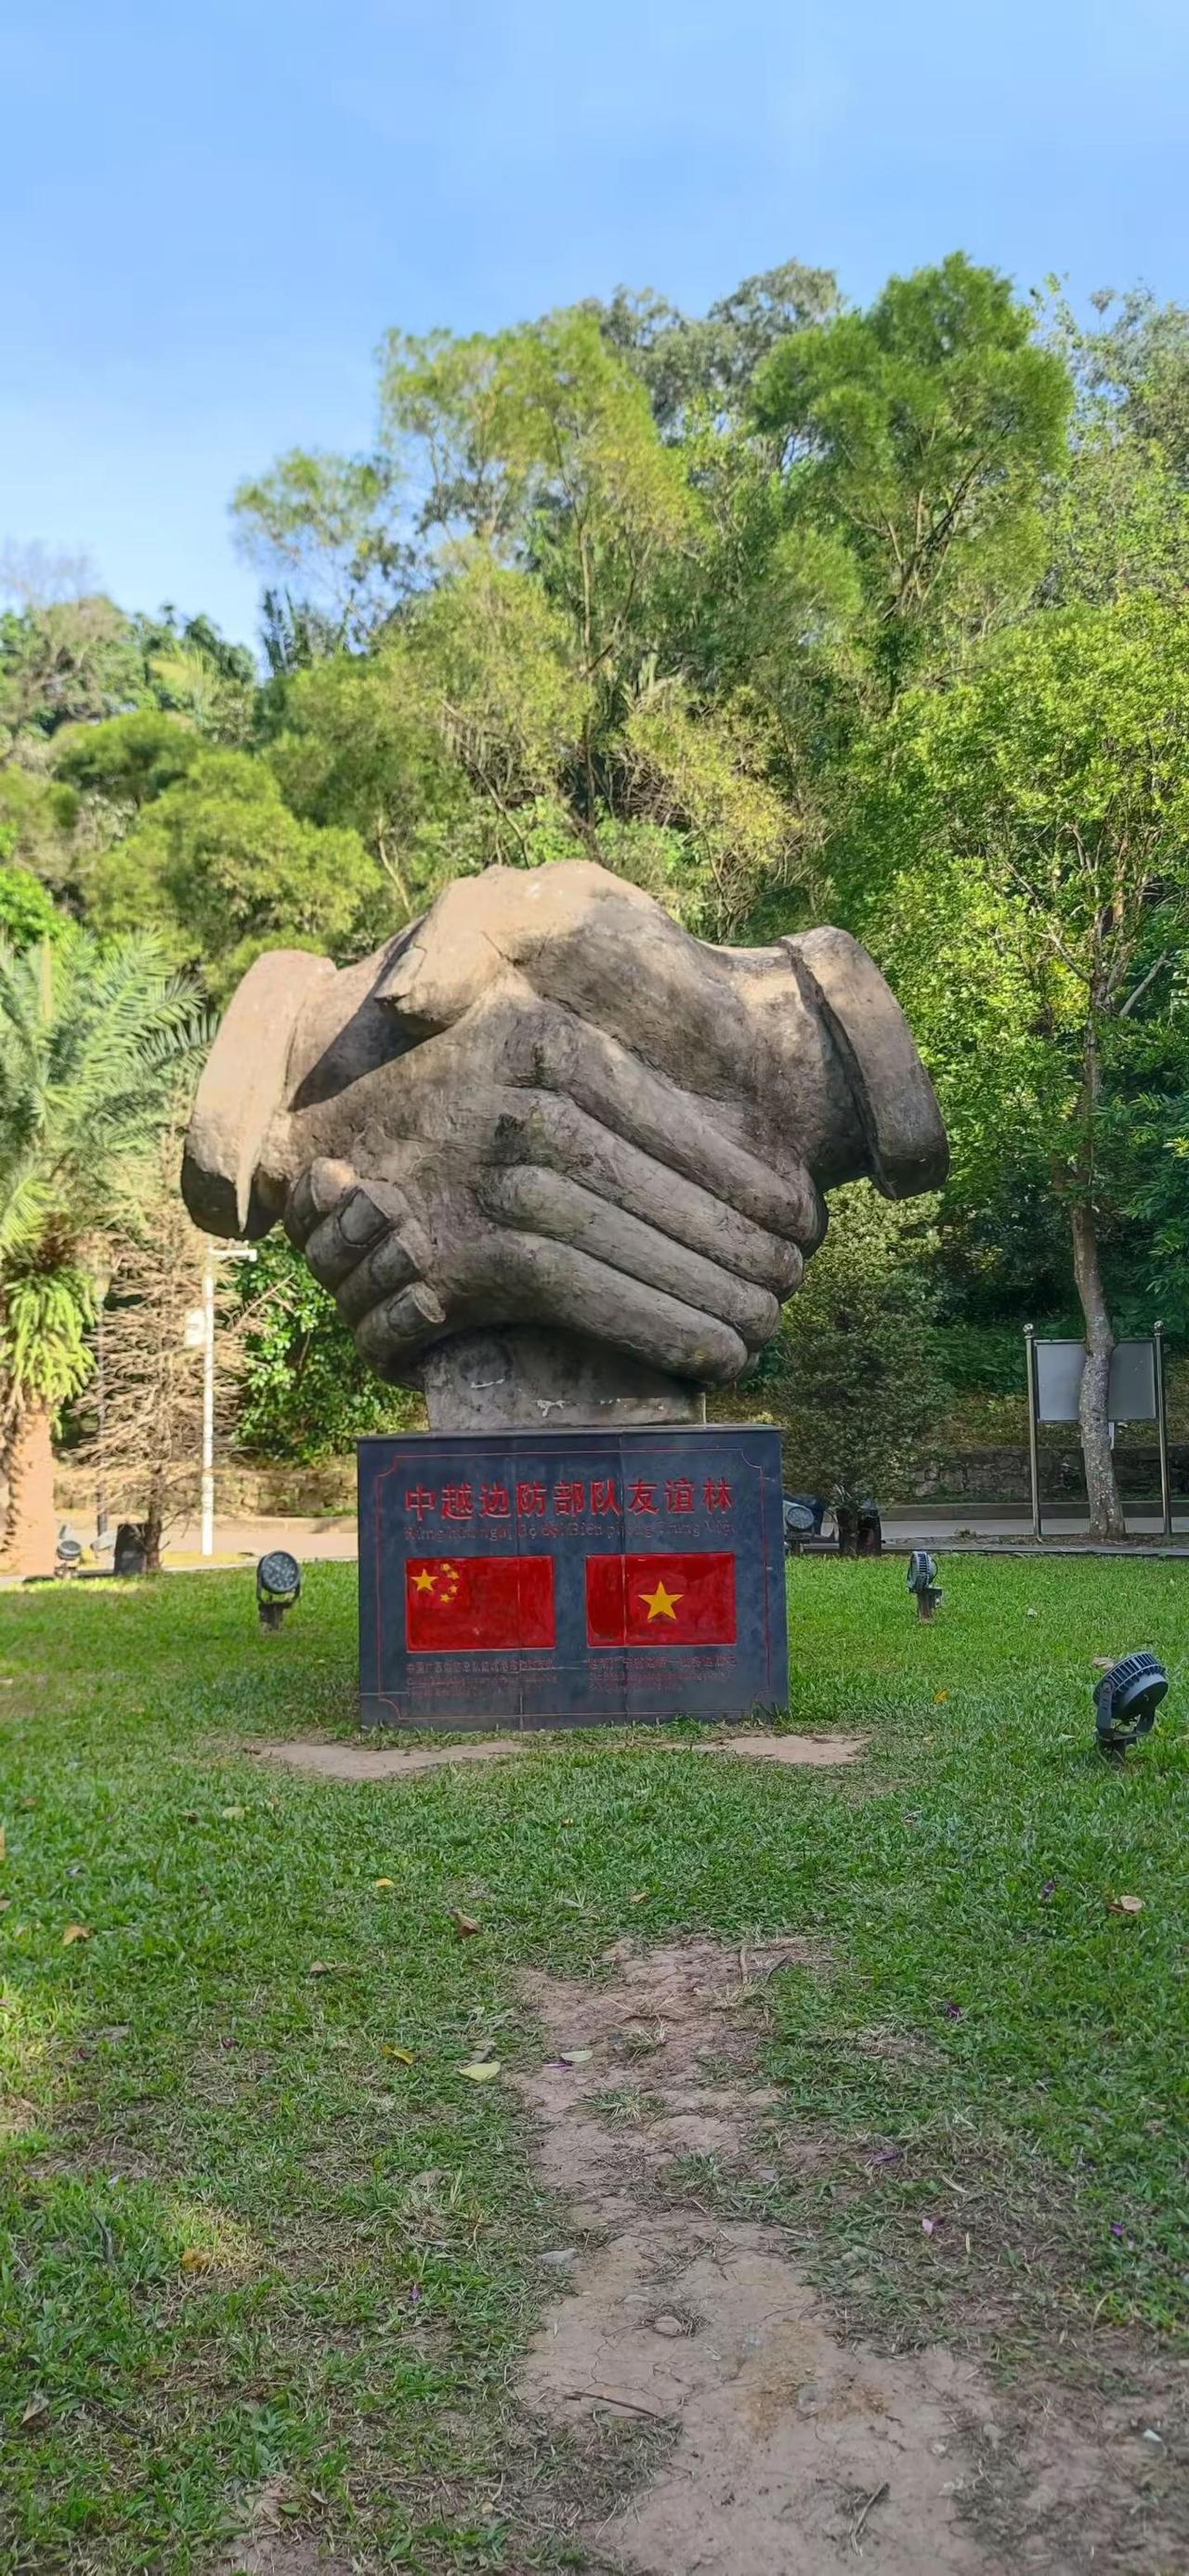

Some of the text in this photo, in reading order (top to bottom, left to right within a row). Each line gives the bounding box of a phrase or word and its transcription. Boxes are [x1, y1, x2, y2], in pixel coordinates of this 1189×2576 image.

[405, 1476, 733, 1521] 中越边防部队友谊林
